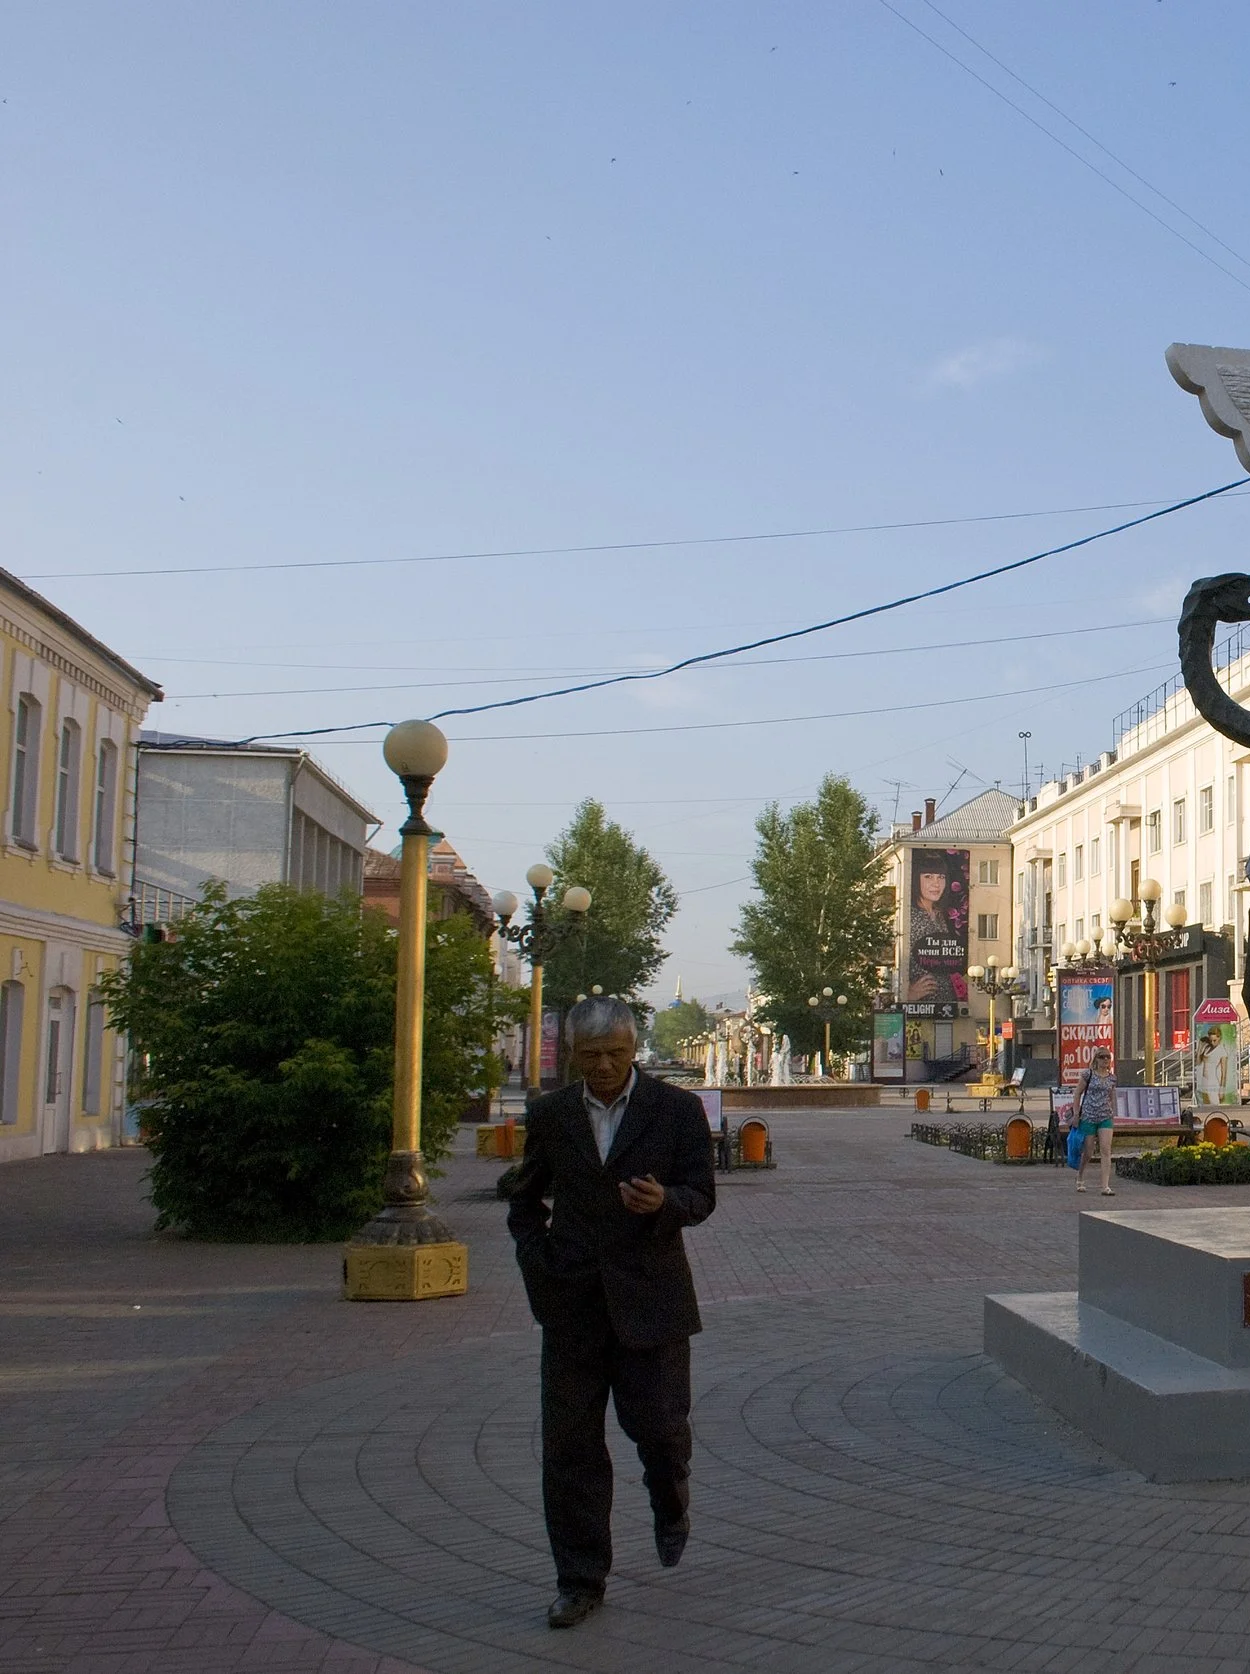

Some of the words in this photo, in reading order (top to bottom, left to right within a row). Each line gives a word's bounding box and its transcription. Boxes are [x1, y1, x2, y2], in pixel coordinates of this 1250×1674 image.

[926, 936, 940, 946] Ты
[941, 939, 957, 947] для
[918, 948, 940, 956] меня
[942, 946, 965, 956] ВСЁ!
[902, 1004, 936, 1015] DELIGHT
[1202, 1003, 1231, 1014] Лиза
[1061, 1026, 1112, 1042] СКИДКИ
[1064, 1053, 1074, 1065] до
